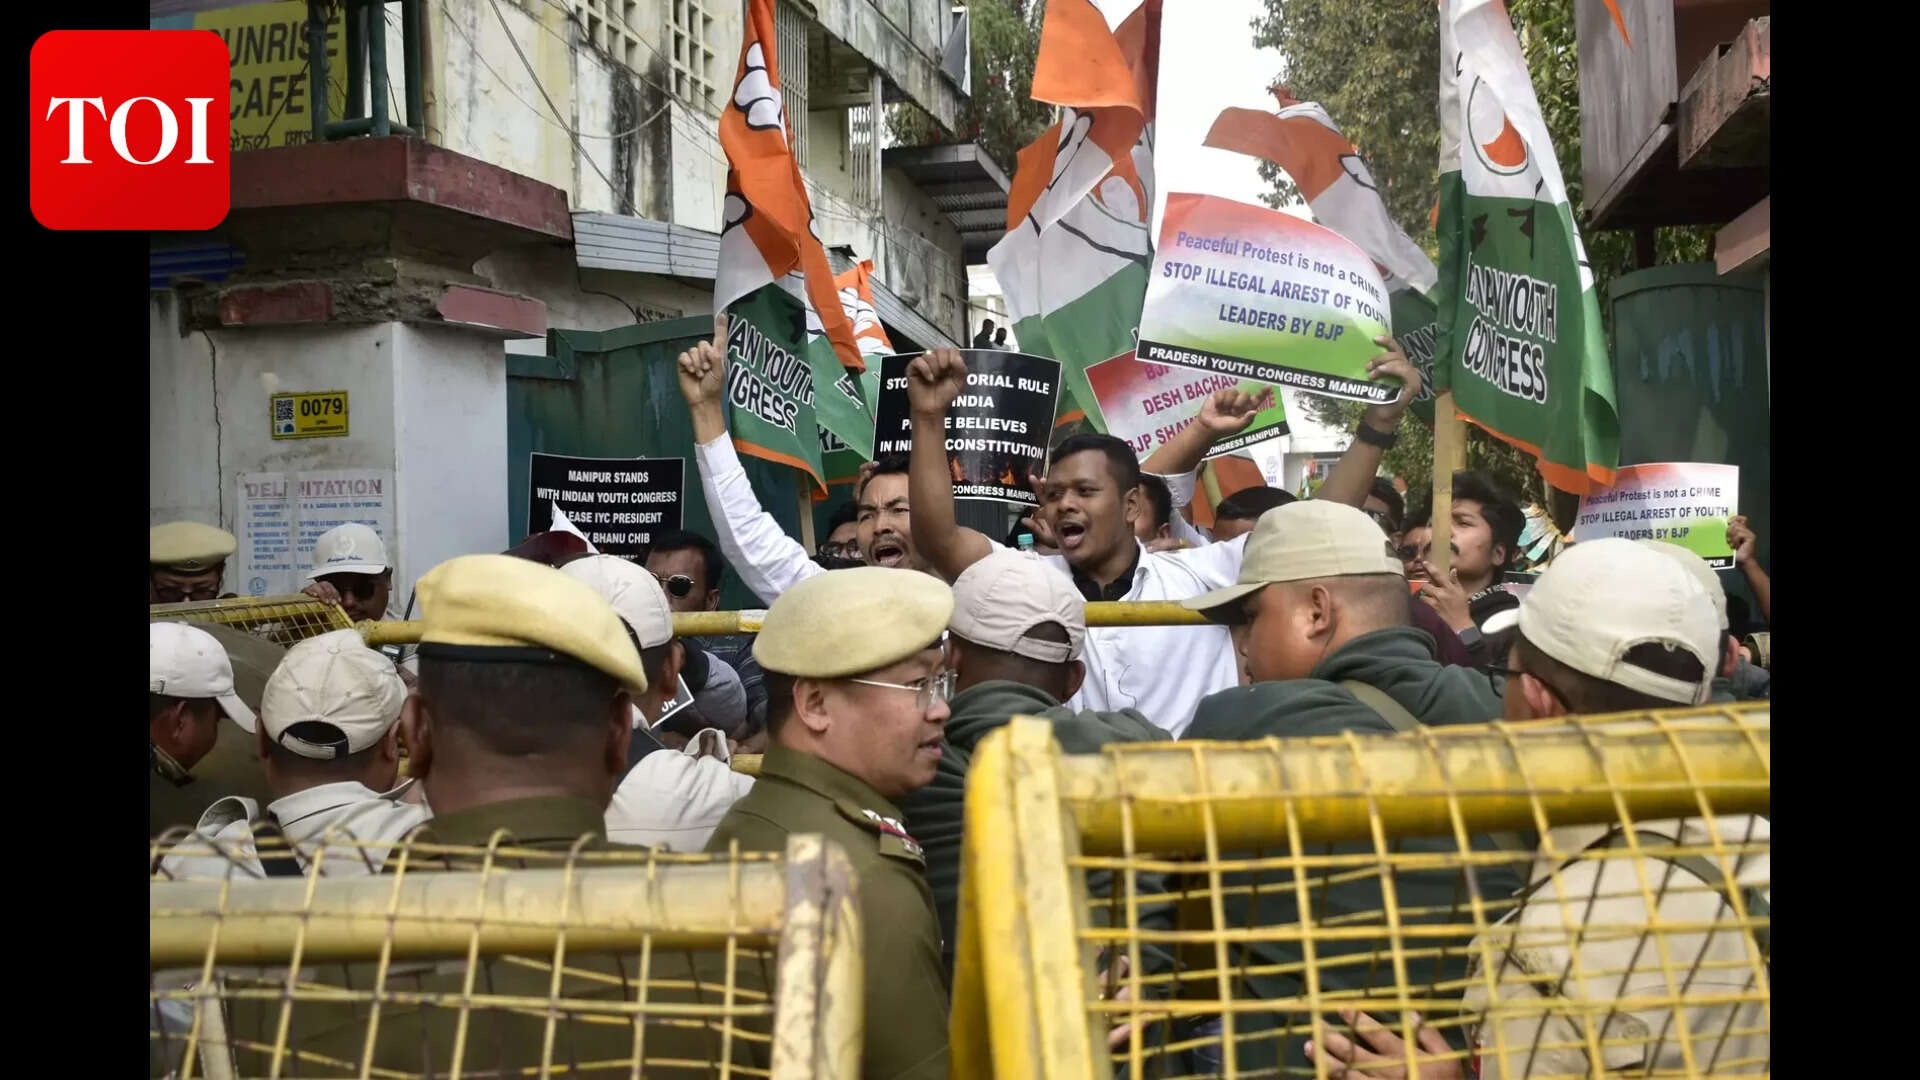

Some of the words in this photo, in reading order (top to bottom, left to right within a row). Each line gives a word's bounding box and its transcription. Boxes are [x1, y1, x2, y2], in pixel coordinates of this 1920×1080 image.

[1176, 231, 1238, 256] Peaceful
[1242, 242, 1294, 267] Protest
[1297, 253, 1309, 269] is
[1313, 261, 1335, 278] not
[1338, 268, 1346, 280] a
[1349, 271, 1382, 304] CRIME
[1163, 261, 1202, 281] STOP
[1205, 267, 1266, 294] ILLEGAL
[1270, 279, 1330, 305] ARREST
[1333, 293, 1351, 310] OF
[1218, 304, 1287, 332] LEADERS
[1290, 315, 1312, 336] BY
[1315, 321, 1344, 342] BJP
[1149, 346, 1207, 367] PRADESH
[1211, 357, 1254, 375] YOUTH
[1257, 360, 1326, 388] CONGRESS
[1328, 380, 1387, 400] MANIPUR
[886, 377, 908, 390] STO
[1018, 378, 1050, 395] RULE
[300, 398, 343, 416] 0079
[1142, 388, 1183, 415] DESH
[955, 417, 1028, 435] BELIEVES
[880, 440, 892, 453] IN
[945, 438, 1044, 460] CONSTITUTION
[1127, 433, 1152, 454] BJP
[1206, 438, 1245, 457] ONGRESS
[1245, 426, 1280, 444] MANIPUR
[568, 470, 612, 483] MANIPUR
[614, 471, 649, 484] STANDS
[537, 487, 560, 501] WITH
[562, 490, 594, 503] INDIAN
[597, 492, 629, 504] YOUTH
[631, 491, 677, 504] CONGRESS
[952, 485, 1005, 497] CONGRESS
[1620, 490, 1651, 501] Protest
[1653, 487, 1661, 499] is
[1663, 488, 1678, 498] not
[1681, 489, 1687, 498] a
[1690, 487, 1721, 498] CRIME
[595, 512, 611, 523] IYC
[613, 512, 663, 524] PRESIDENT
[1580, 512, 1600, 525] STOP
[1602, 510, 1638, 523] ILLEGAL
[1640, 508, 1676, 520] ARREST
[1679, 507, 1691, 518] OF
[1694, 506, 1729, 517] YOUTH
[593, 532, 626, 544] BHANU
[628, 532, 650, 544] CHIB
[1656, 528, 1668, 539] BY
[1671, 527, 1689, 538] BJP
